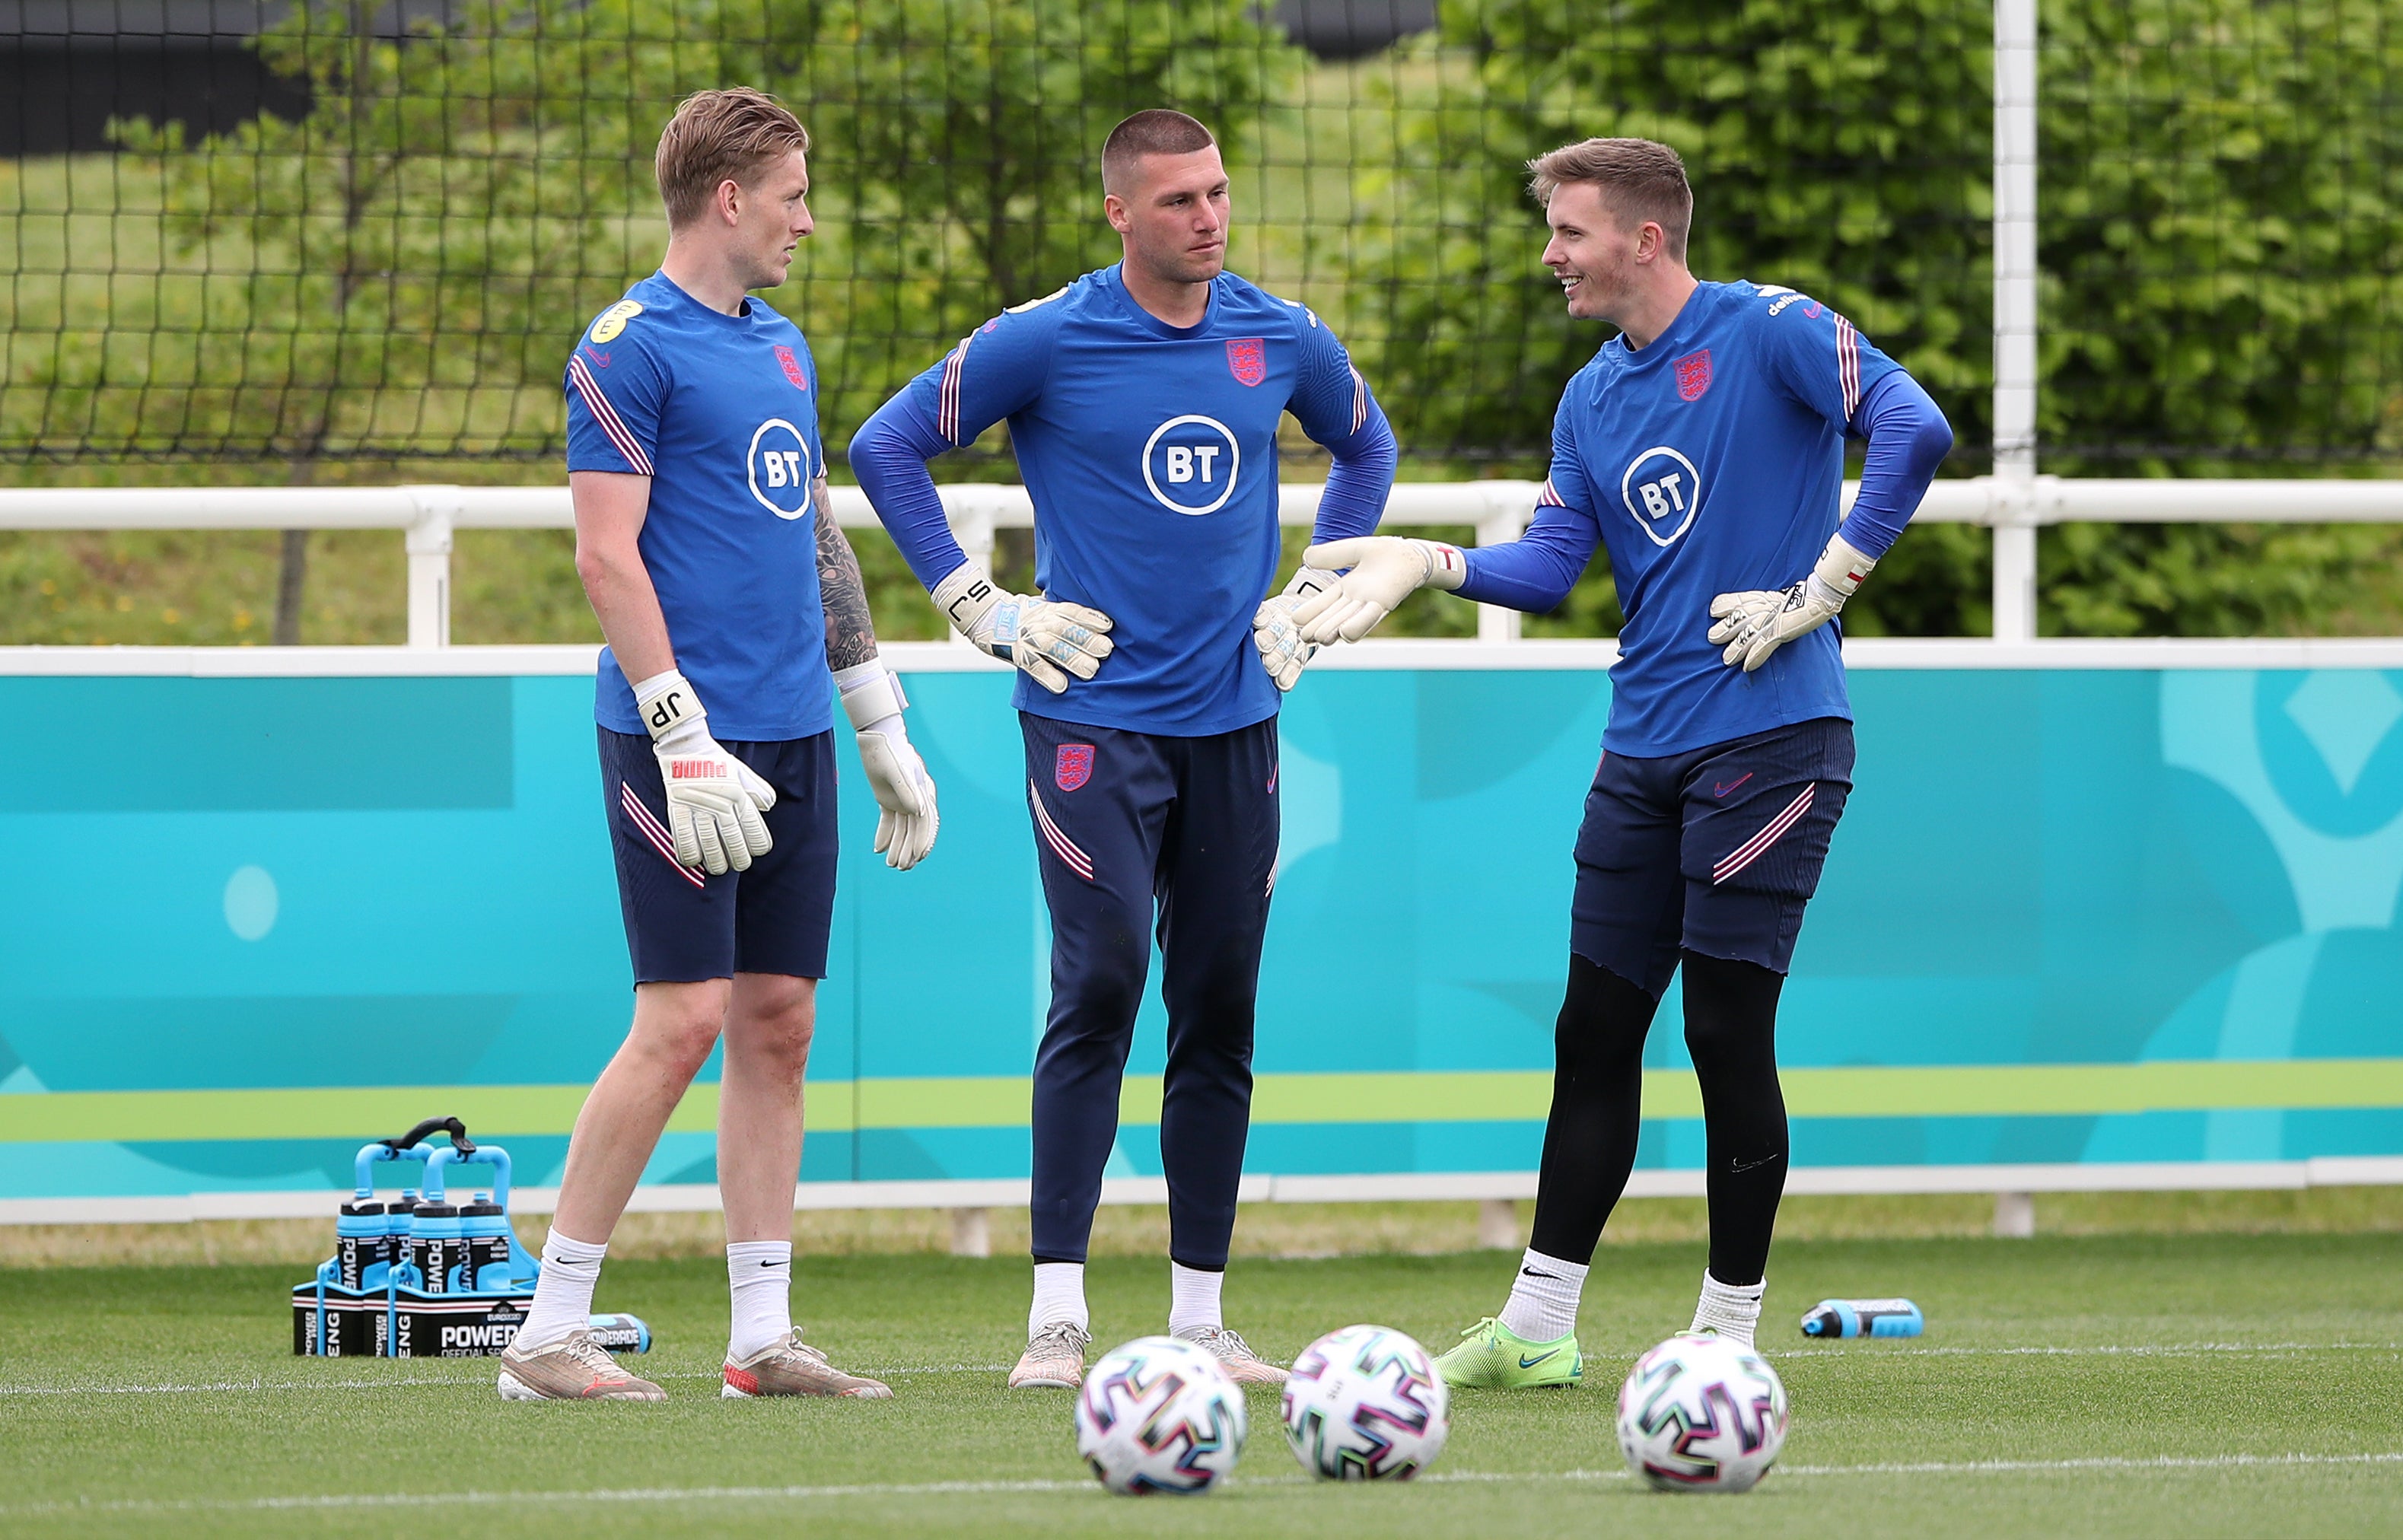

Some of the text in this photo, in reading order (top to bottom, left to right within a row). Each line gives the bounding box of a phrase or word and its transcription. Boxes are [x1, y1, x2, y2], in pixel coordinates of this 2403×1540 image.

[763, 450, 800, 488] BT
[1166, 446, 1219, 483] BT
[1638, 473, 1685, 520] BT
[651, 692, 680, 728] JP
[672, 761, 727, 778] PUMA
[327, 1312, 340, 1357] ENG
[398, 1315, 411, 1359] ENG
